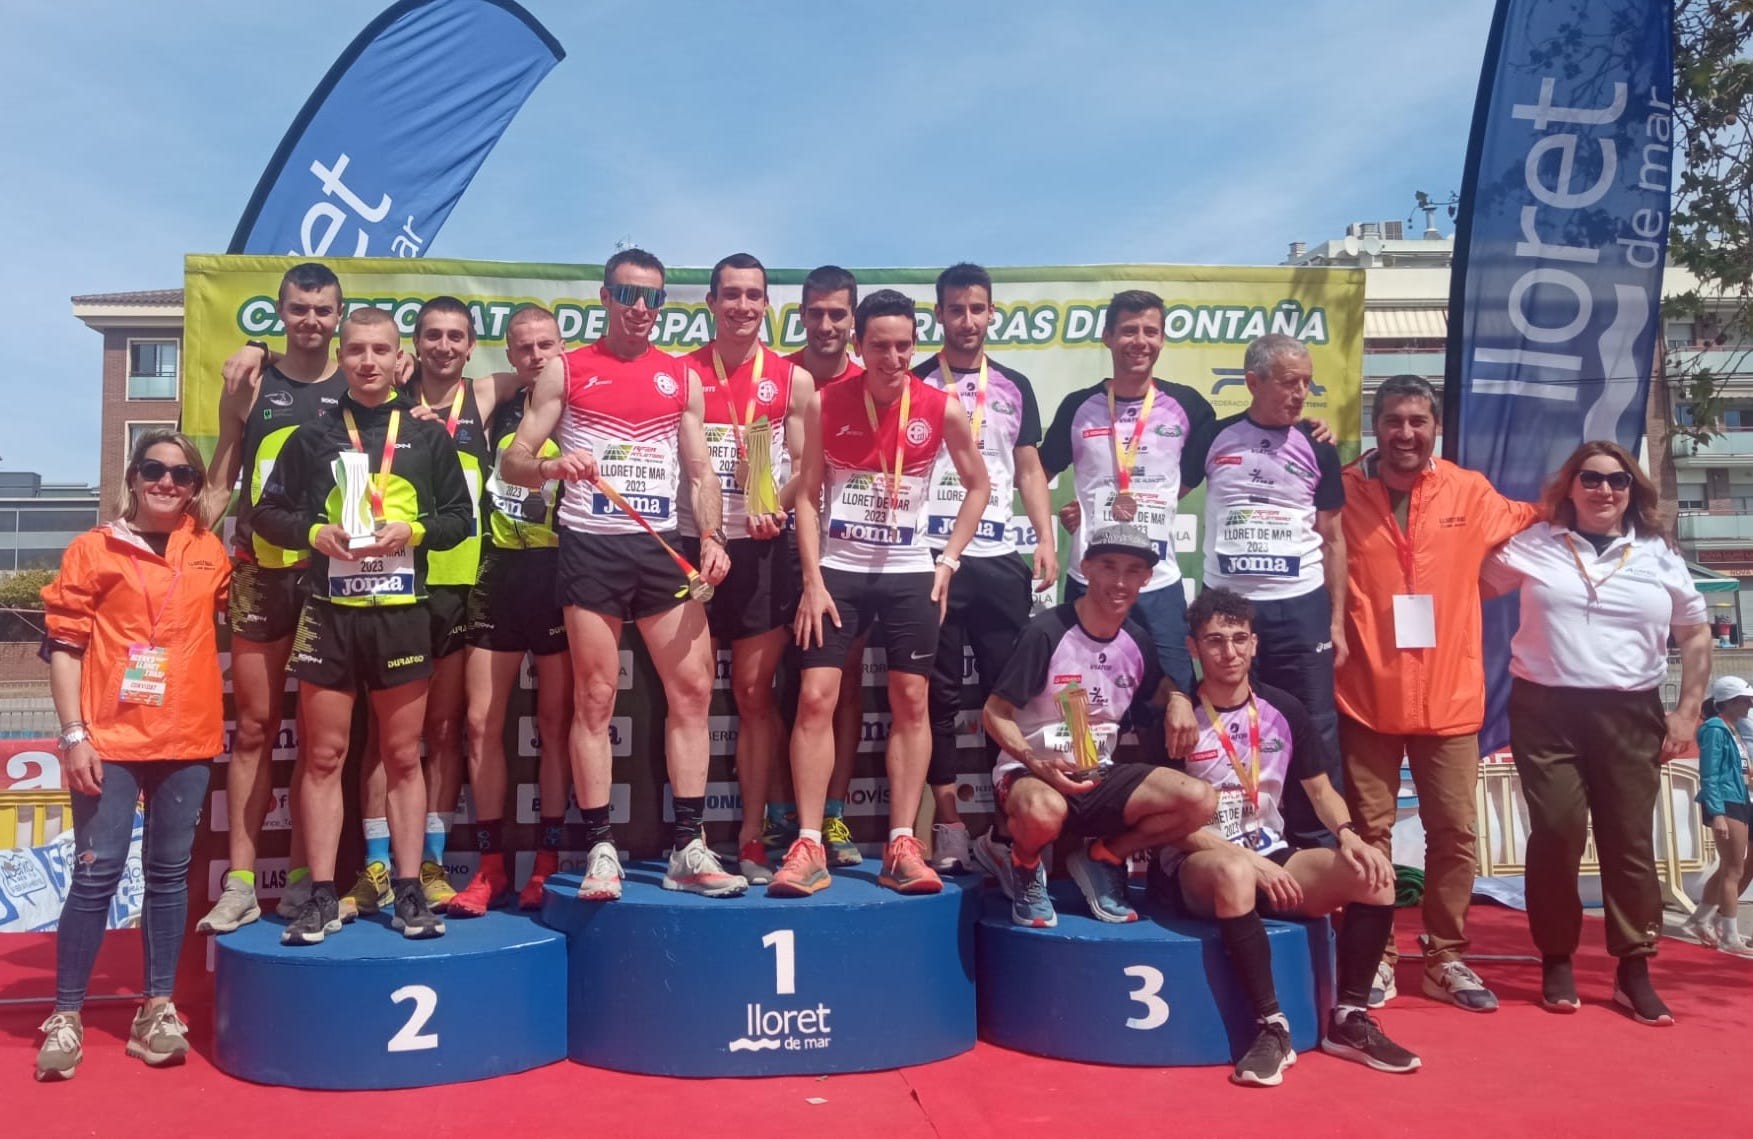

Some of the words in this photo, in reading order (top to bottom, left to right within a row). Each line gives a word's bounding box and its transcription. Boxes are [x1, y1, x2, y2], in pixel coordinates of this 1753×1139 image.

[1638, 86, 1671, 191] mar
[1471, 77, 1628, 401] lloret
[1616, 208, 1663, 270] de
[1165, 303, 1326, 341] ONTAÑA
[600, 464, 634, 478] LLORET
[635, 466, 647, 478] DE
[649, 467, 666, 480] MAR
[506, 485, 522, 498] 2023
[625, 480, 646, 492] 2023
[842, 492, 875, 507] LLORET
[876, 496, 889, 509] DE
[864, 509, 886, 523] 2023
[1137, 511, 1149, 523] DE
[1150, 513, 1166, 525] MAR
[1224, 528, 1256, 541] LLORET
[1257, 528, 1270, 540] DE
[1271, 529, 1292, 541] MAR
[1246, 541, 1269, 553] 2023
[361, 560, 384, 573] 2023
[762, 929, 795, 994] 1
[1123, 965, 1170, 1030] 3
[388, 985, 438, 1052] 2
[747, 1003, 831, 1036] lloret
[784, 1036, 801, 1050] de
[804, 1037, 832, 1049] mar
